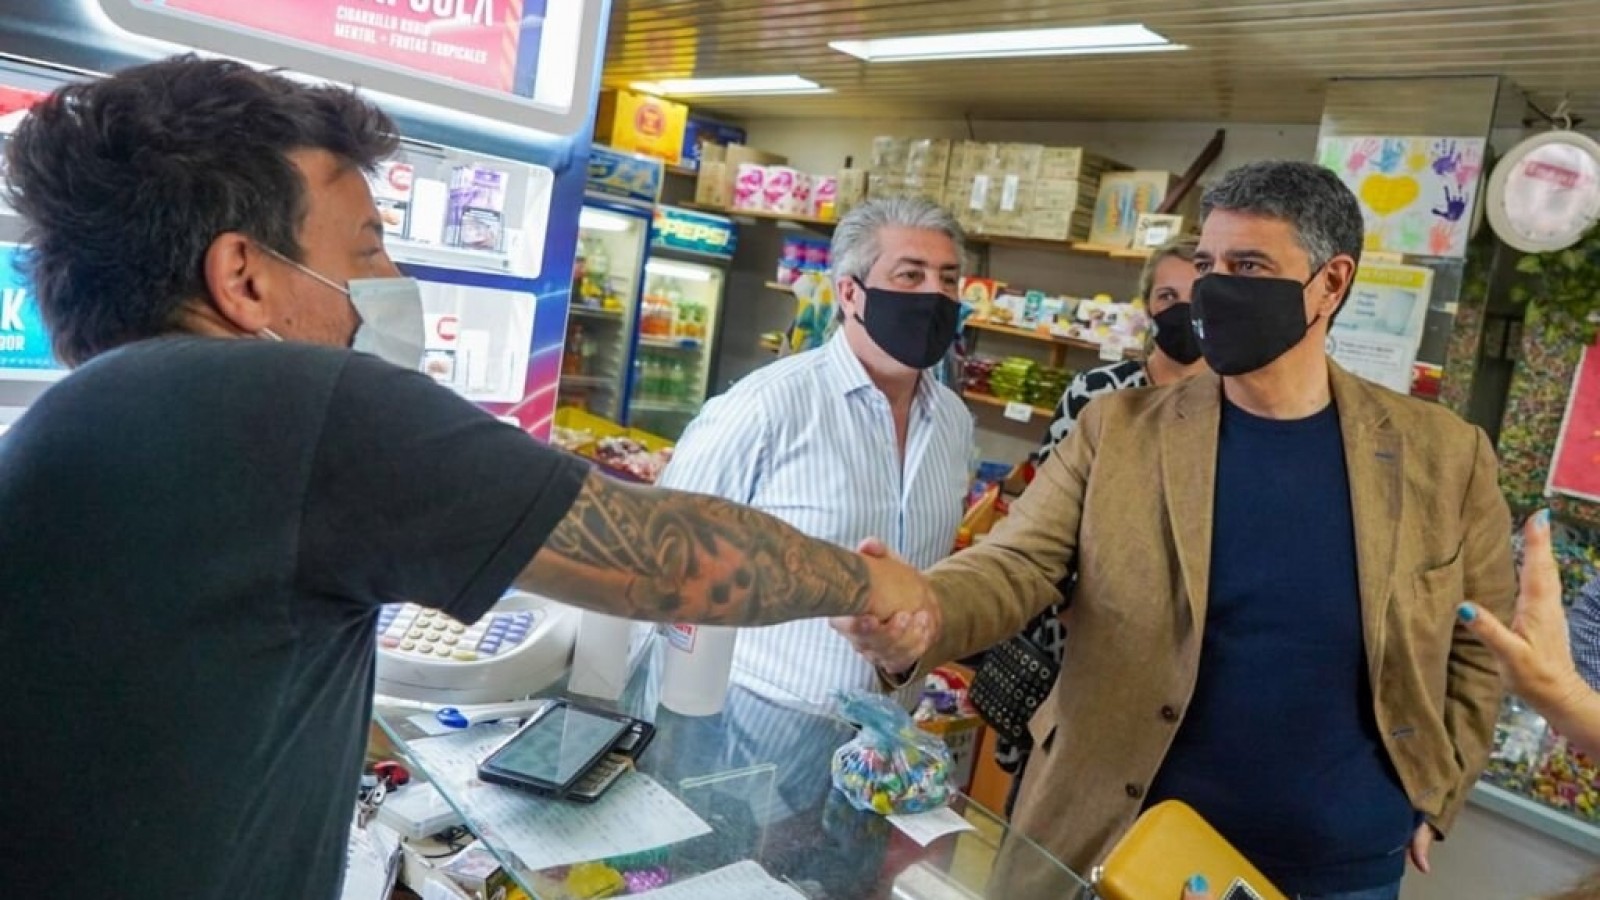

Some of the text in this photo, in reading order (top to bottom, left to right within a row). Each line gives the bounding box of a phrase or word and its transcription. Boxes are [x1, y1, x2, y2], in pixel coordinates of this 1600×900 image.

[336, 5, 398, 30] CIGARRILLO
[334, 23, 376, 44] MENTOL
[389, 33, 428, 53] FRUTAS
[431, 40, 488, 65] TROPICALES
[660, 218, 731, 247] PEPSI
